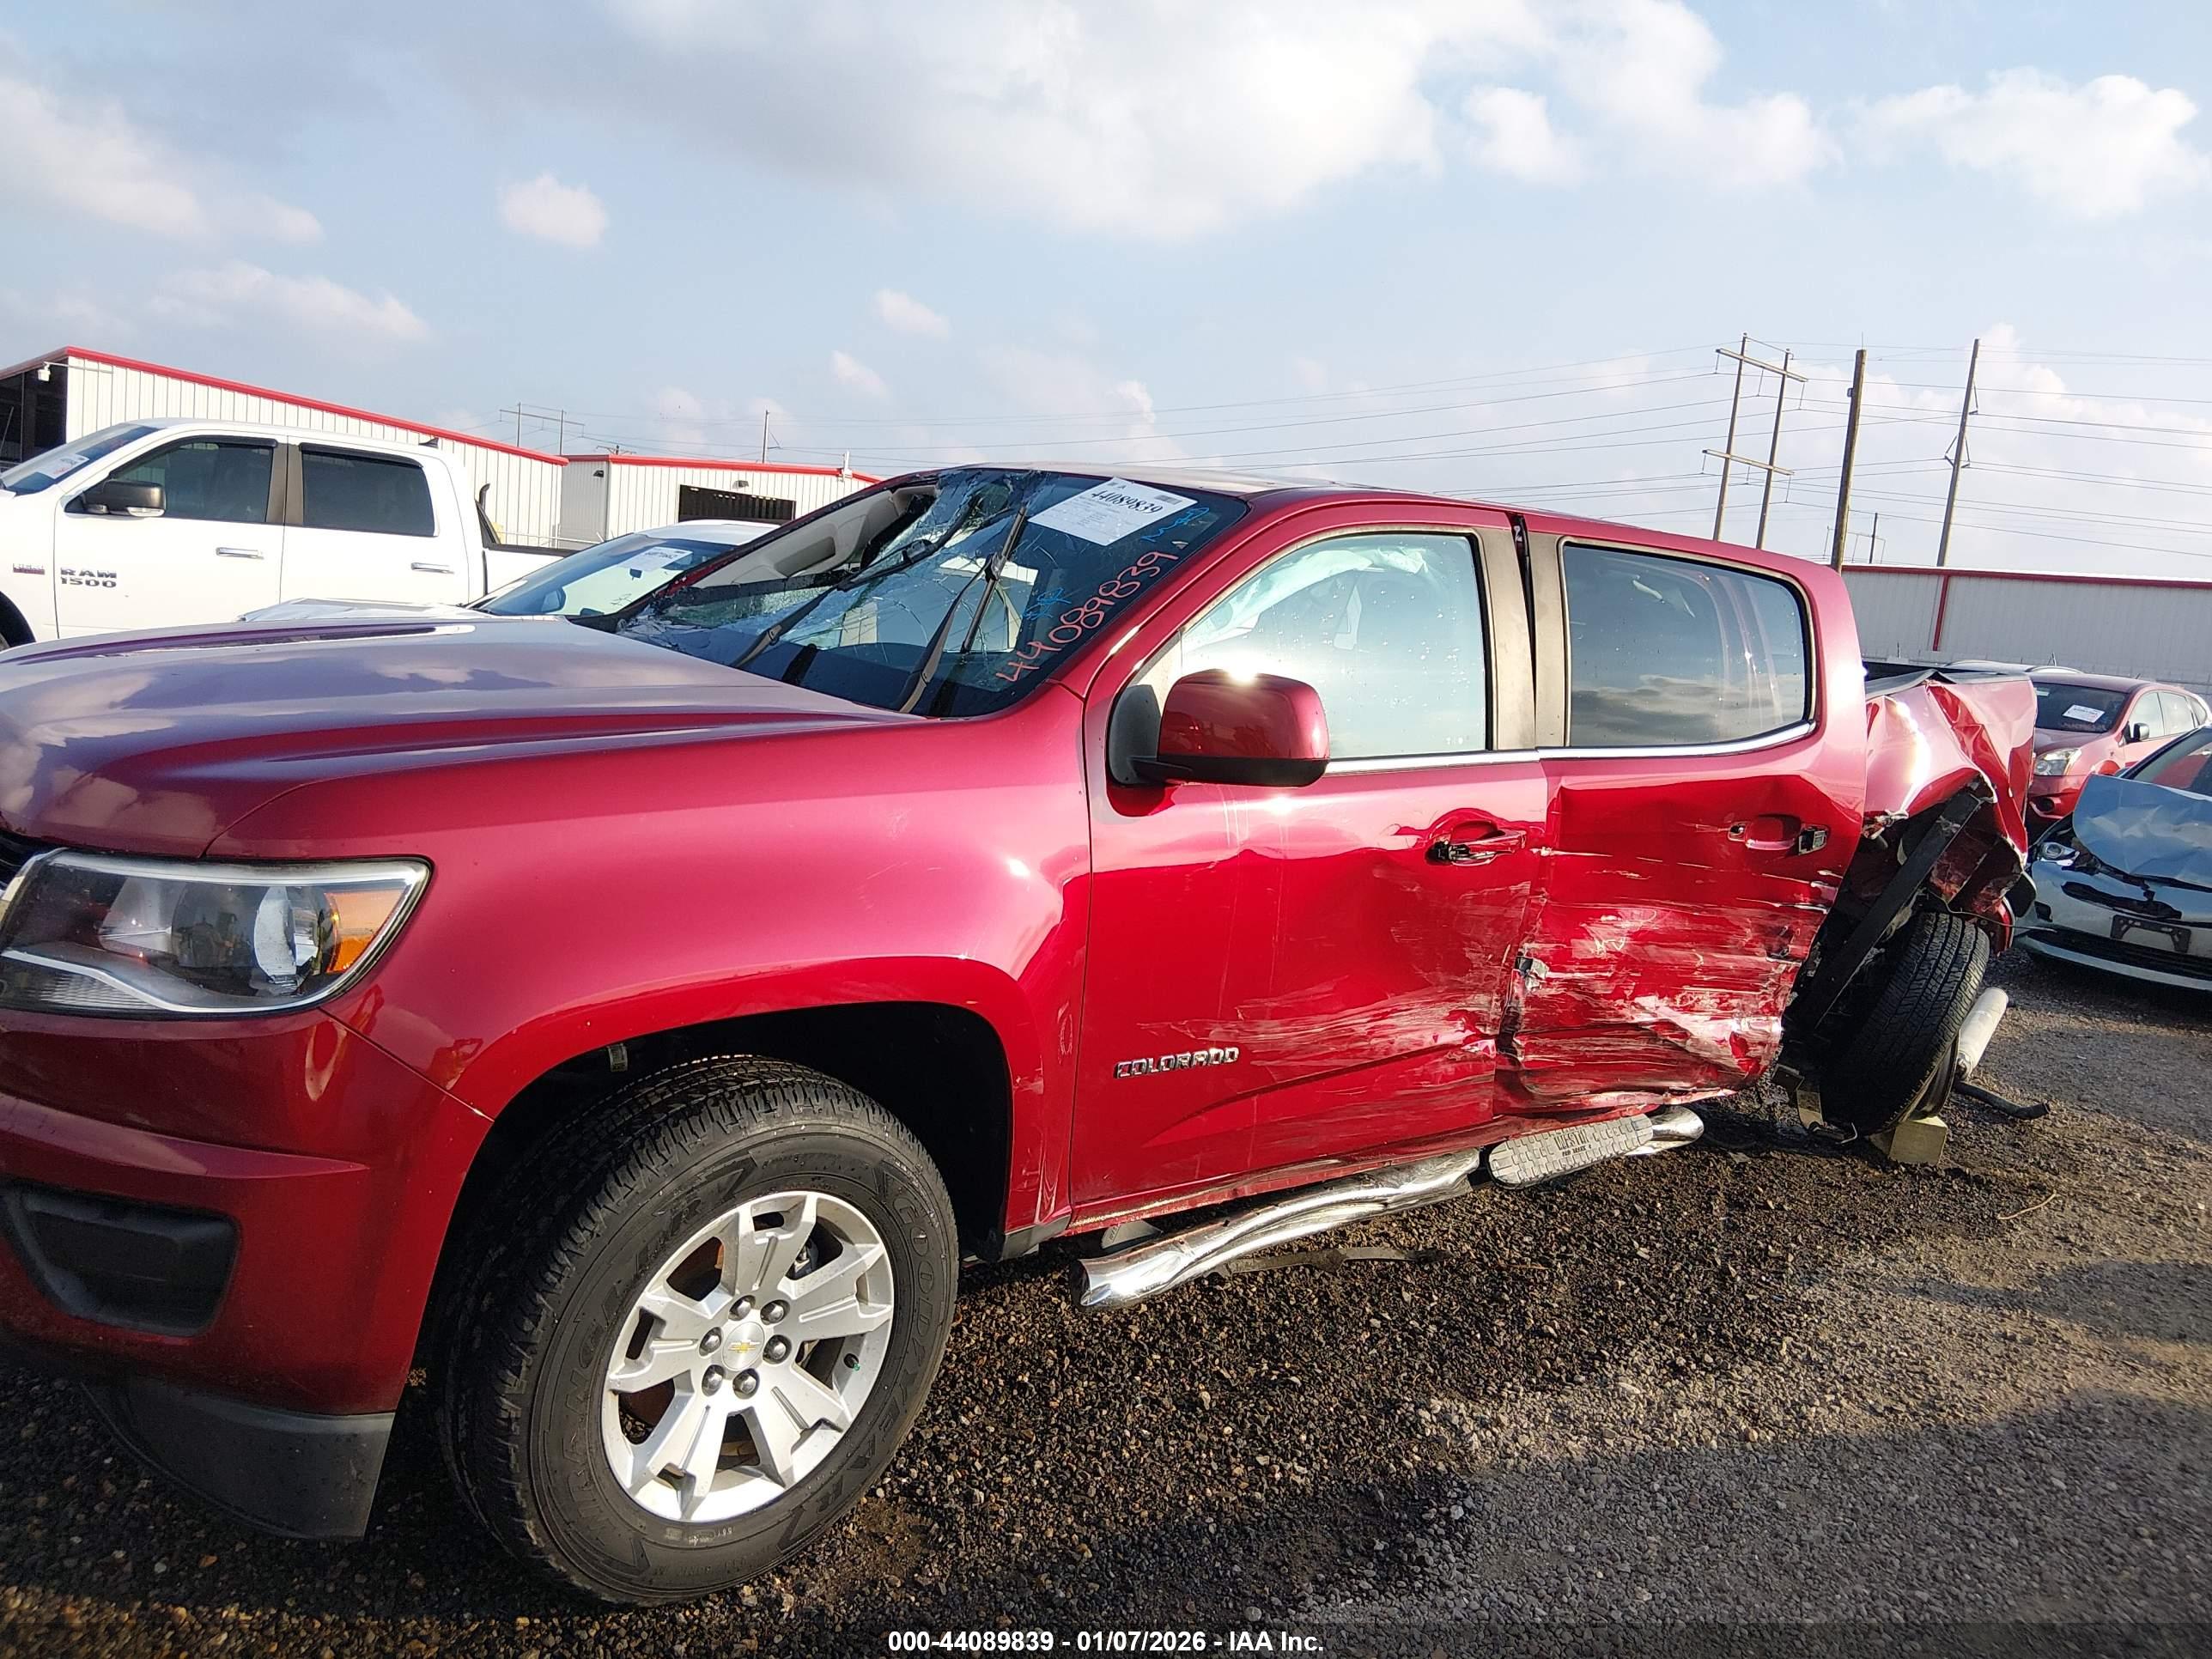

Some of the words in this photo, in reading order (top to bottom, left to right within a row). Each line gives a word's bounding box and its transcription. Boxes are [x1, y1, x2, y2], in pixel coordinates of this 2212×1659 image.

[1091, 489, 1164, 514] 44089839
[60, 568, 117, 579] RAM
[60, 576, 117, 588] 1500
[995, 550, 1180, 683] 44089839
[1114, 1047, 1240, 1079] COLORADO
[811, 1194, 934, 1517] GOODYEAR
[562, 1198, 702, 1547] WRANGLER
